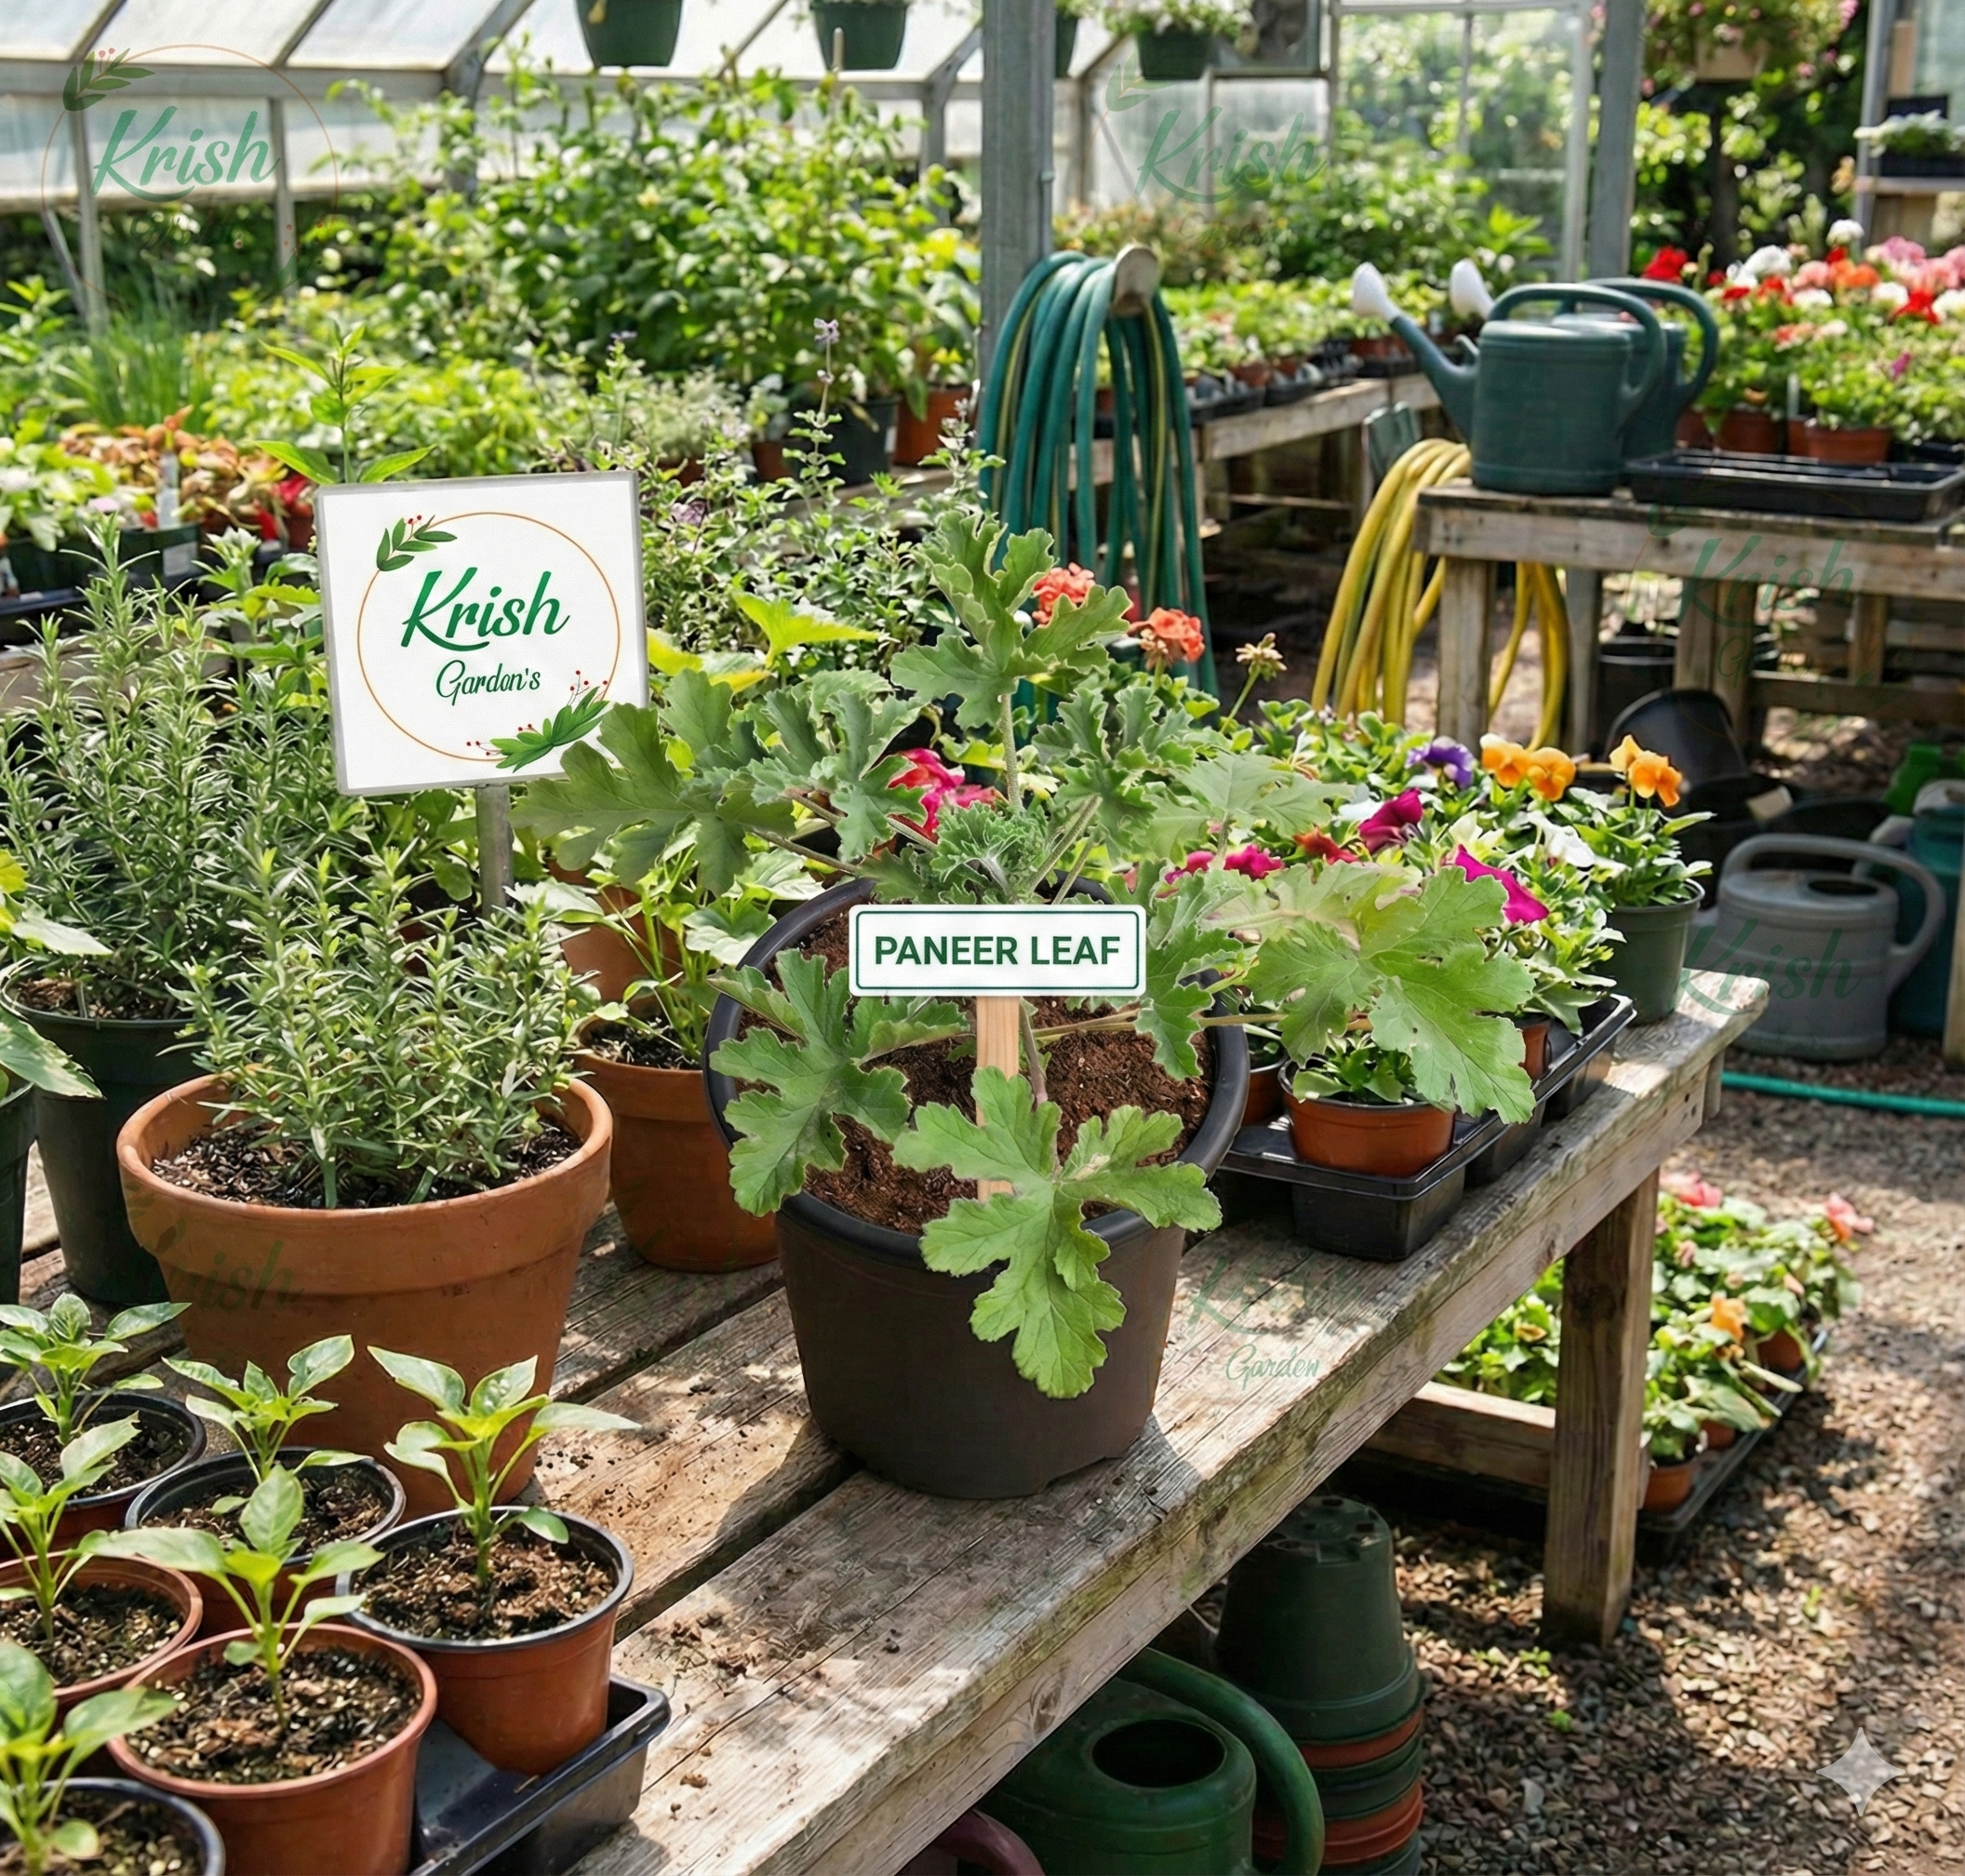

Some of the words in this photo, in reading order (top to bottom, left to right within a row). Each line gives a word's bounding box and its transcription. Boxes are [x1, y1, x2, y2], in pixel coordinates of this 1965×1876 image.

[400, 566, 571, 652] Krish
[875, 935, 1019, 965] PANEER
[1031, 935, 1121, 965] LEAF
